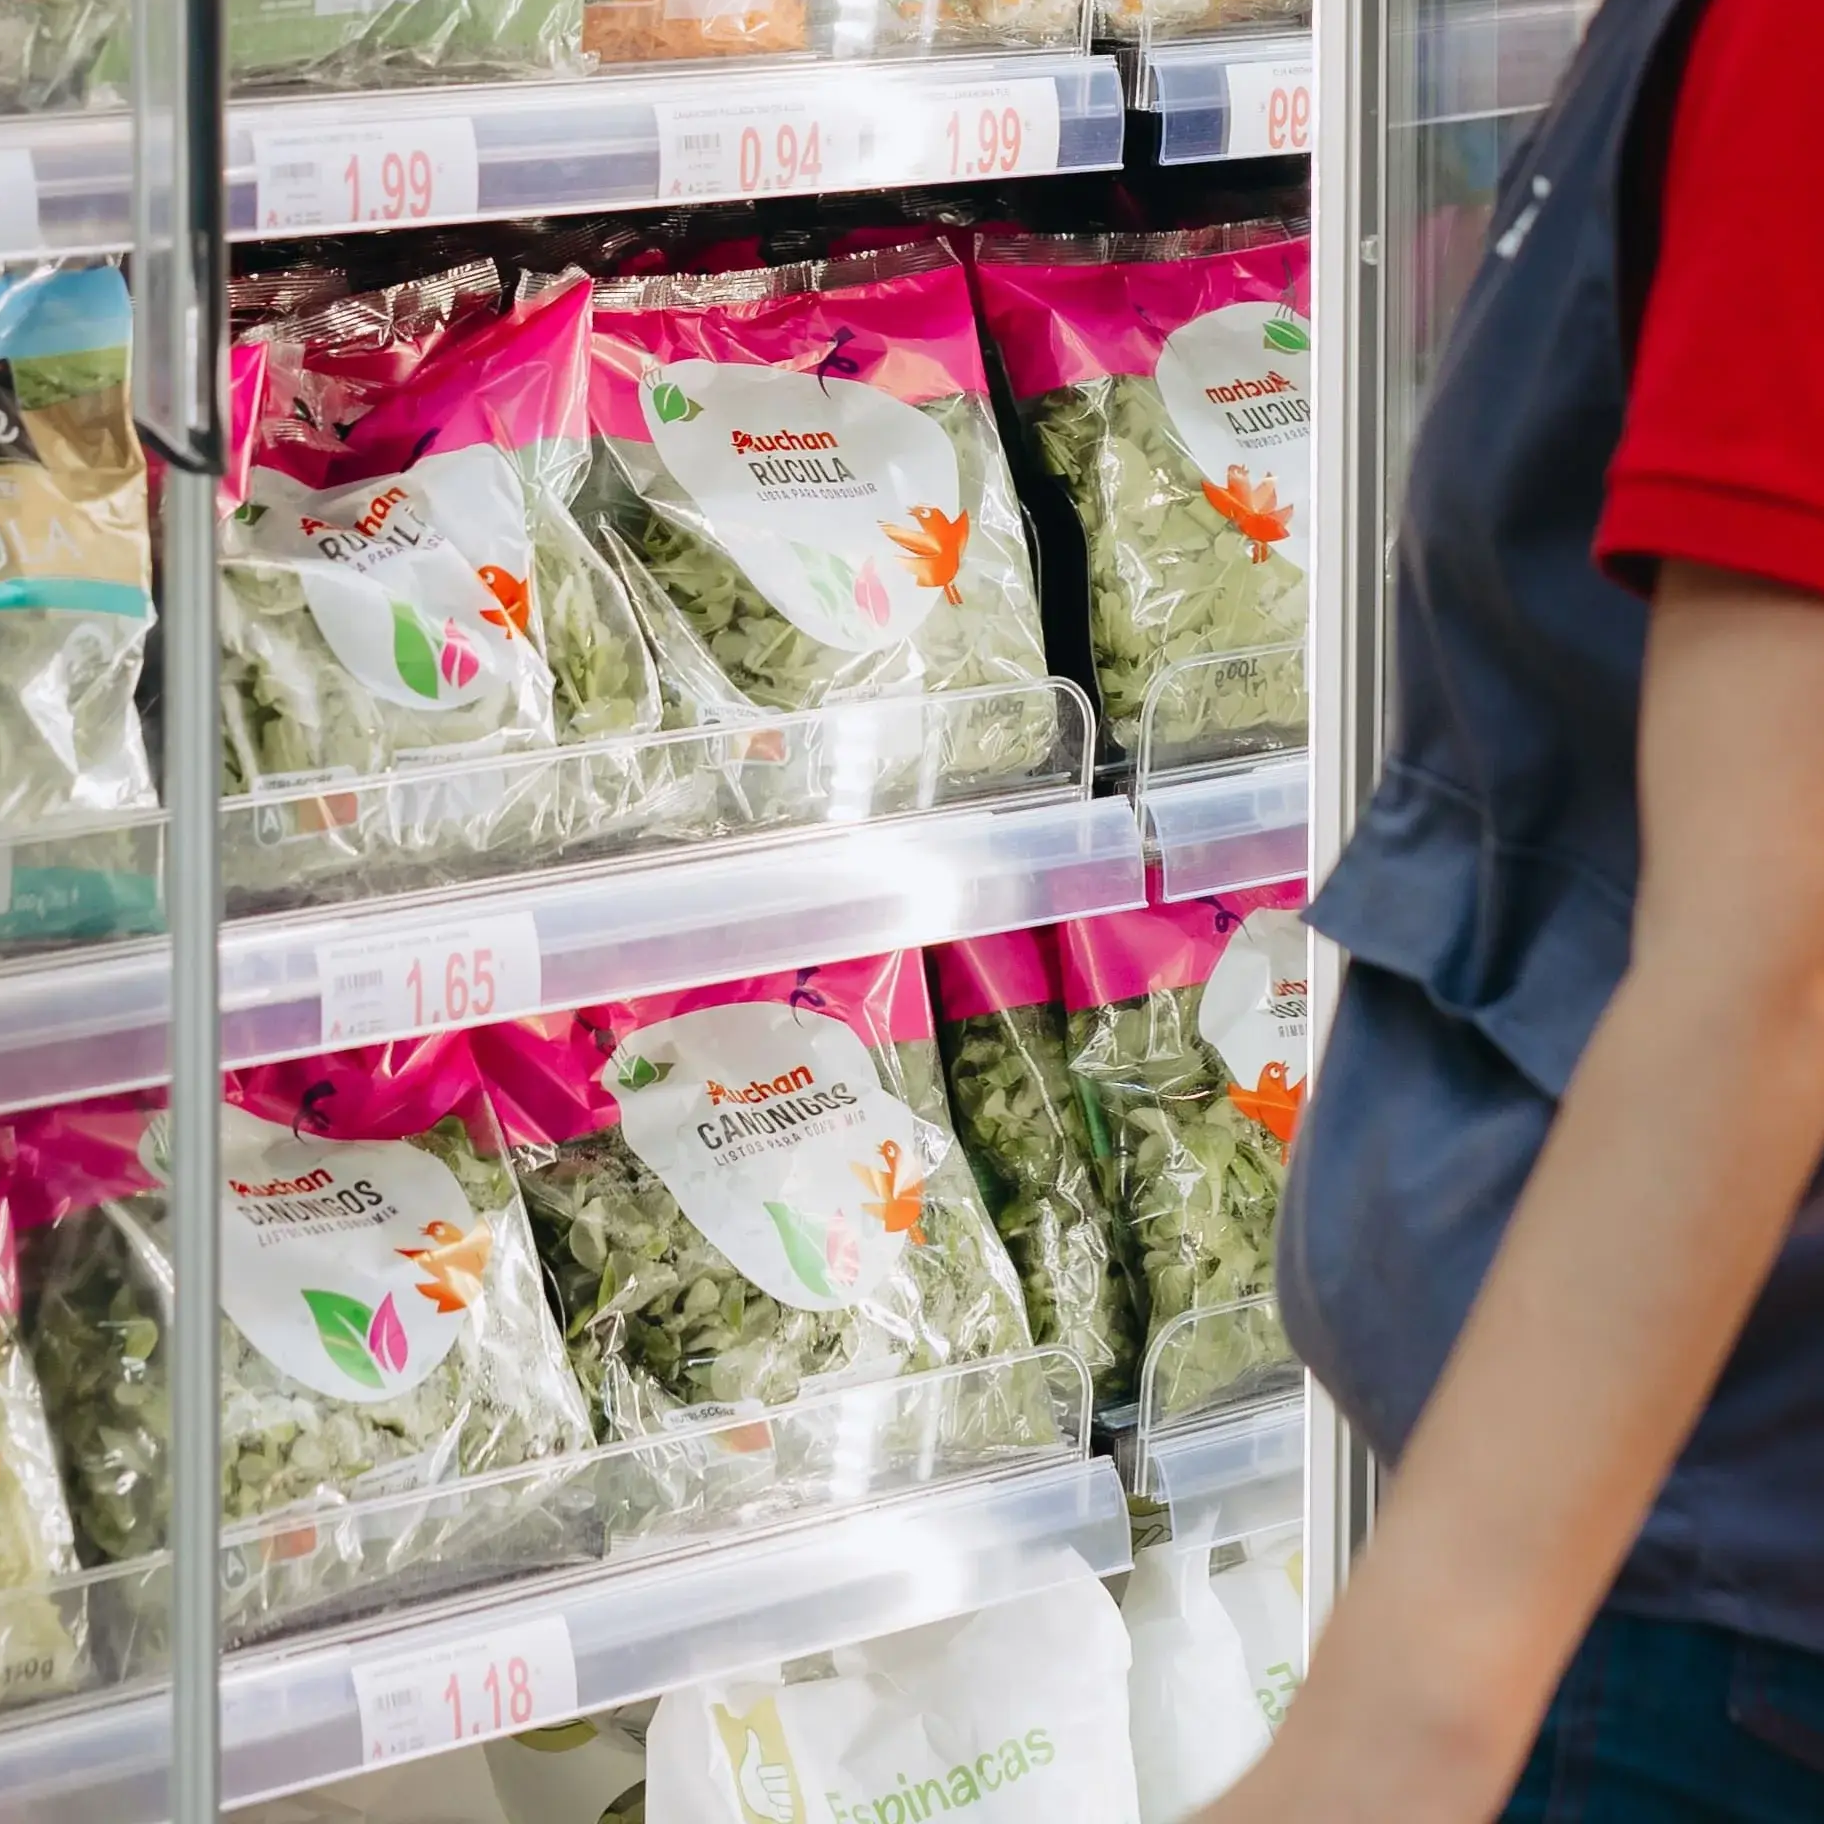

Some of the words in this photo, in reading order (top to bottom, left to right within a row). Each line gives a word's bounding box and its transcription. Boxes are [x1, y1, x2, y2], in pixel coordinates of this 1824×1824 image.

[739, 121, 824, 192] 0.94
[947, 106, 1022, 175] 1.99
[344, 150, 433, 223] 1.99
[731, 429, 840, 455] Auchan
[748, 455, 857, 487] RÚCULA
[756, 490, 791, 503] LISTA
[791, 487, 821, 500] PARA
[819, 482, 878, 500] CONSUMIR
[301, 487, 409, 537] Ahan
[406, 948, 496, 1029] 1.65
[706, 1064, 814, 1106] Auchan
[697, 1082, 858, 1151] CANÓNIGOS
[713, 1140, 765, 1167] LISTOS
[767, 1132, 803, 1150] PARA
[228, 1168, 334, 1198] Auchan
[237, 1179, 384, 1227] CANÓNIGOS
[444, 1656, 534, 1741] 1.18
[824, 1725, 1056, 1824] Espinacas
